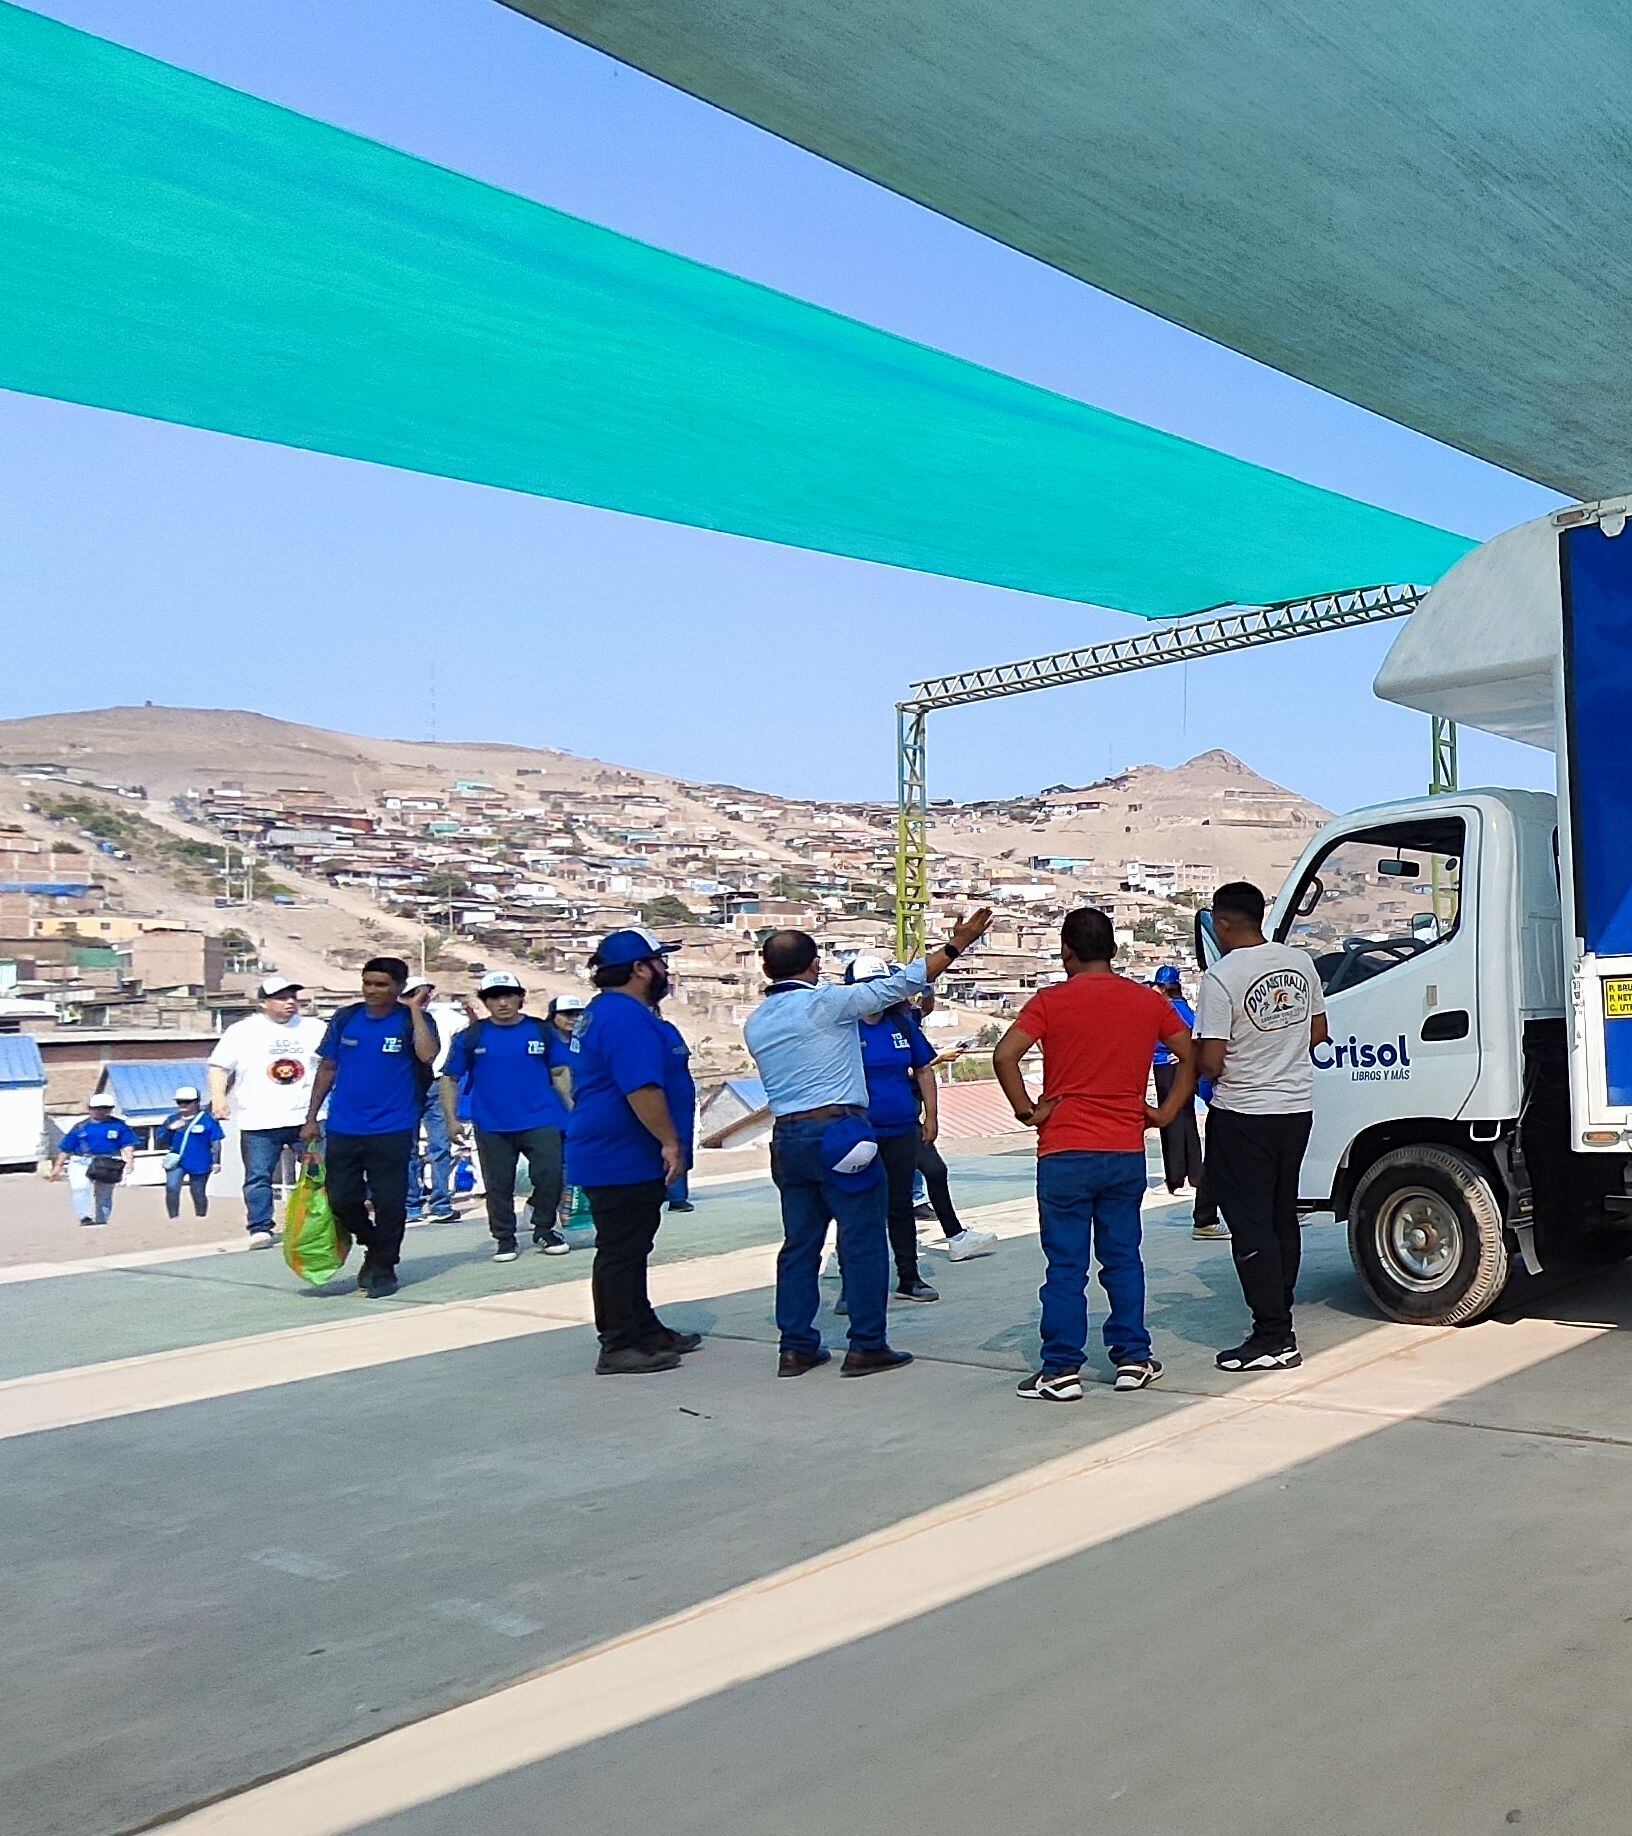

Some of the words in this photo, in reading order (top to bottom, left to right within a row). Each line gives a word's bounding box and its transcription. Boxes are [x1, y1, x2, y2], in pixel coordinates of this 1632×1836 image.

[1308, 1034, 1411, 1070] Crisol
[1351, 1070, 1382, 1082] LIBROS
[1383, 1070, 1390, 1081] Y
[1390, 1069, 1410, 1081] MÁS
